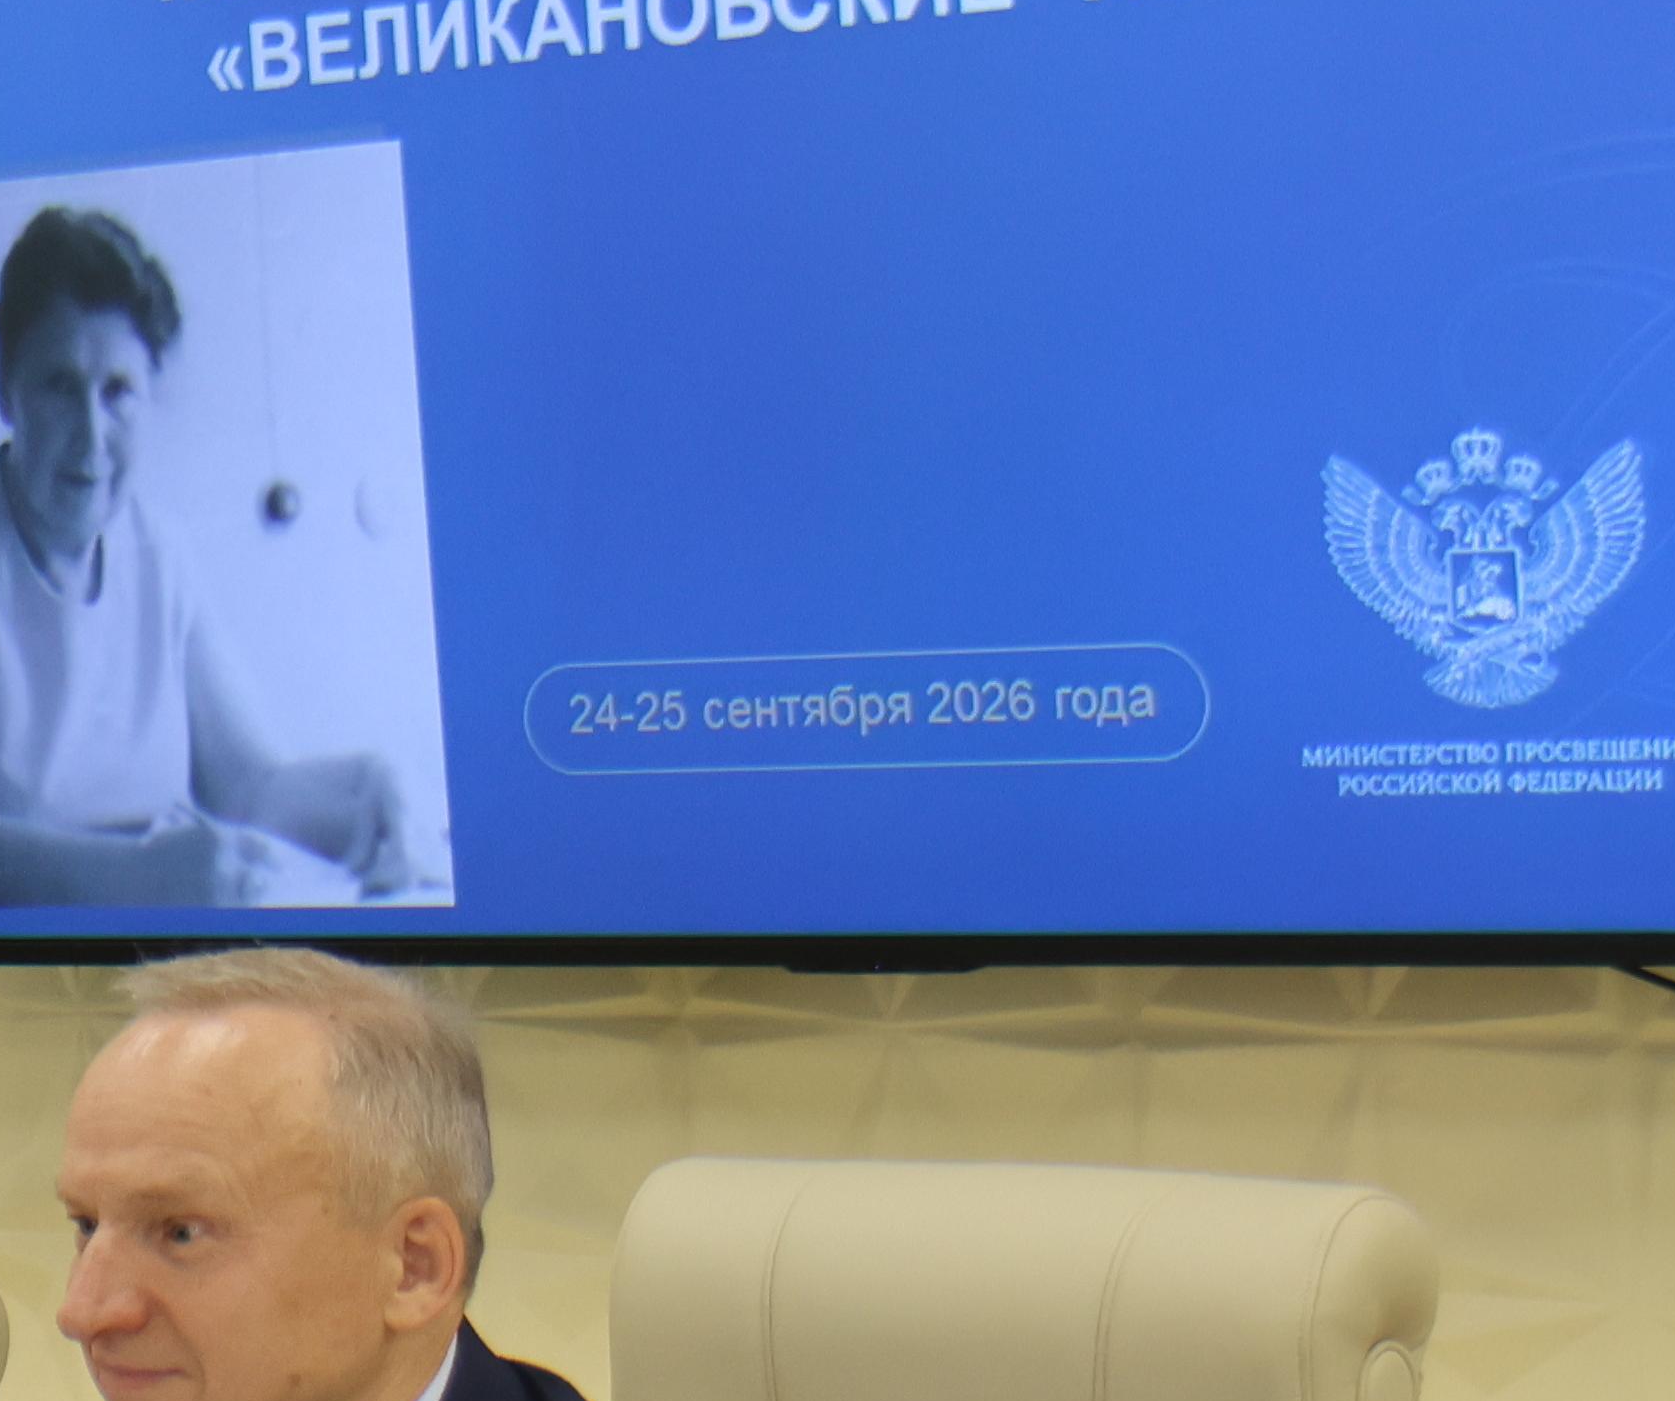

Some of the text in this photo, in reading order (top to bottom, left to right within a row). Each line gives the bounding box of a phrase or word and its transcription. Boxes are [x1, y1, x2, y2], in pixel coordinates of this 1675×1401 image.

[570, 680, 1155, 735] 24-25 сентября 2026 года
[1301, 741, 1498, 767] МИНИСТЕРСТВО
[1338, 768, 1663, 797] РОССИЙСКОЙ ФЕДЕРАЦИИ
